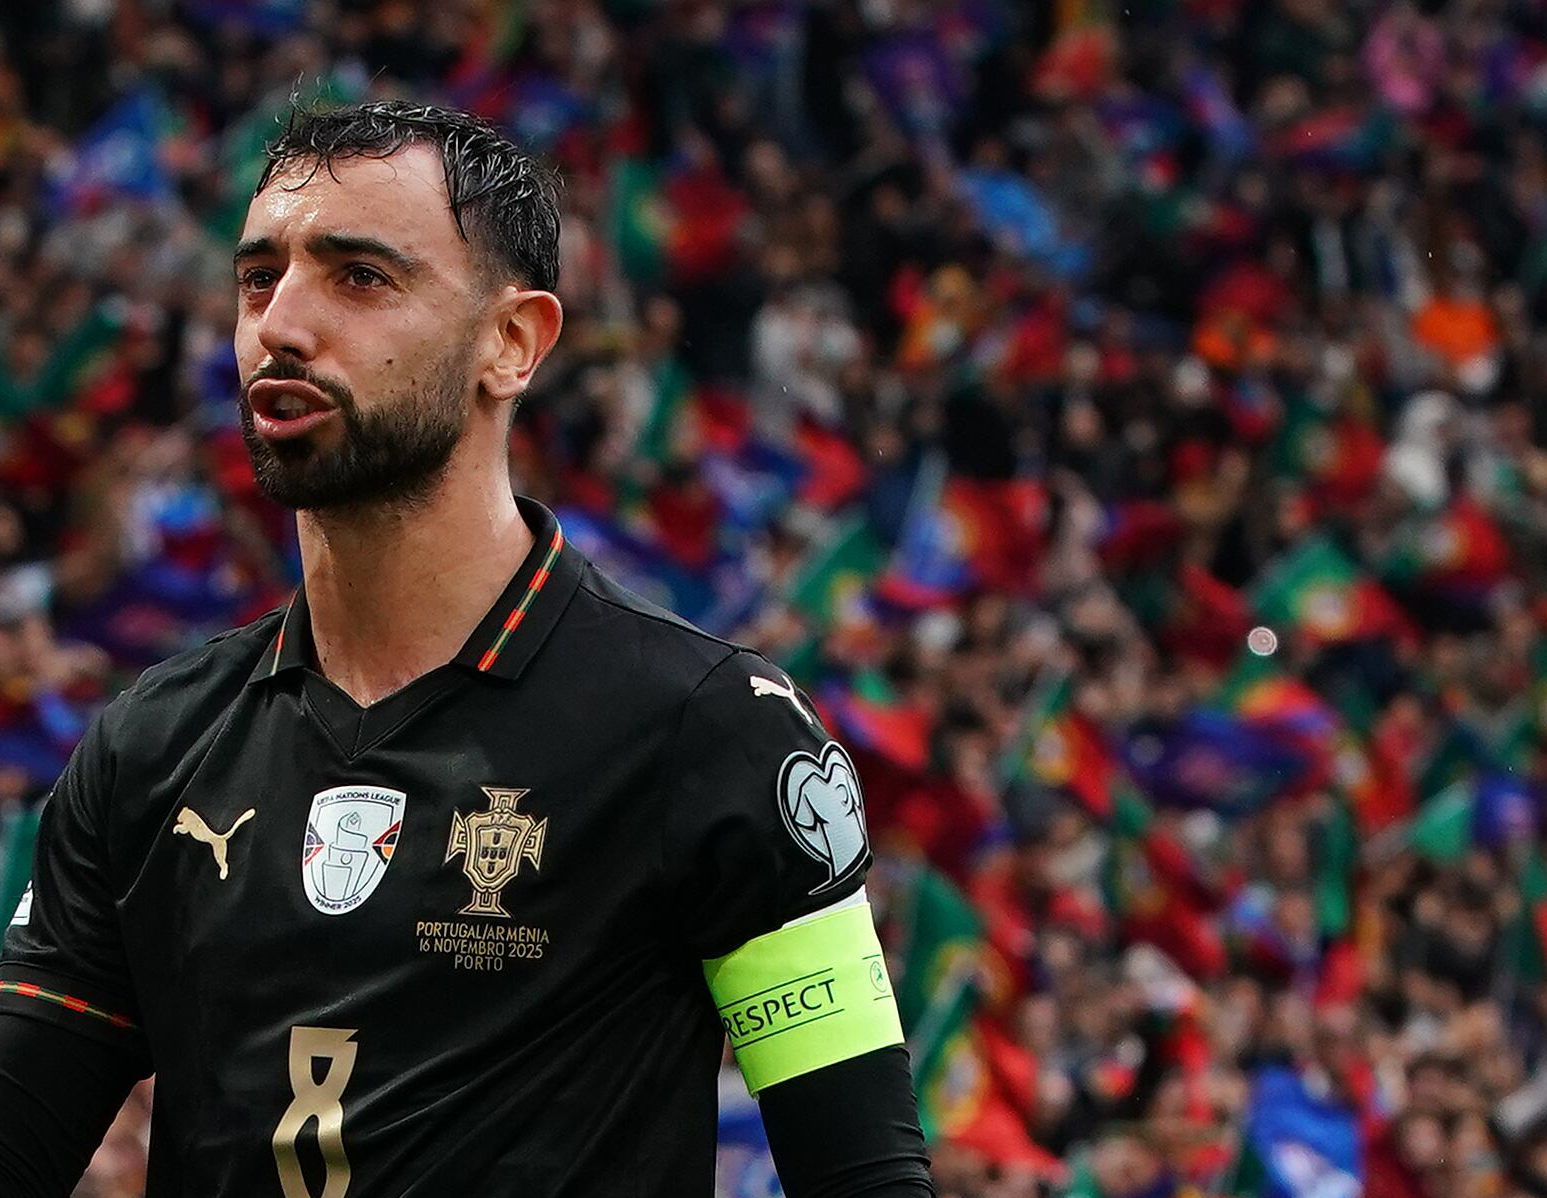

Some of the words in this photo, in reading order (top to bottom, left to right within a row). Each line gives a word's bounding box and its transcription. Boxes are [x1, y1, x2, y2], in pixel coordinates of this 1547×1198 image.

[335, 791, 370, 800] NATIONS
[370, 792, 402, 806] LEAGUE
[415, 921, 550, 944] PORTUGAL/ARMÉNIA
[419, 938, 431, 952] 16
[433, 938, 505, 957] NOVEMBRO
[508, 943, 544, 959] 2025
[454, 954, 503, 972] PORTO
[722, 978, 835, 1041] RESPECT
